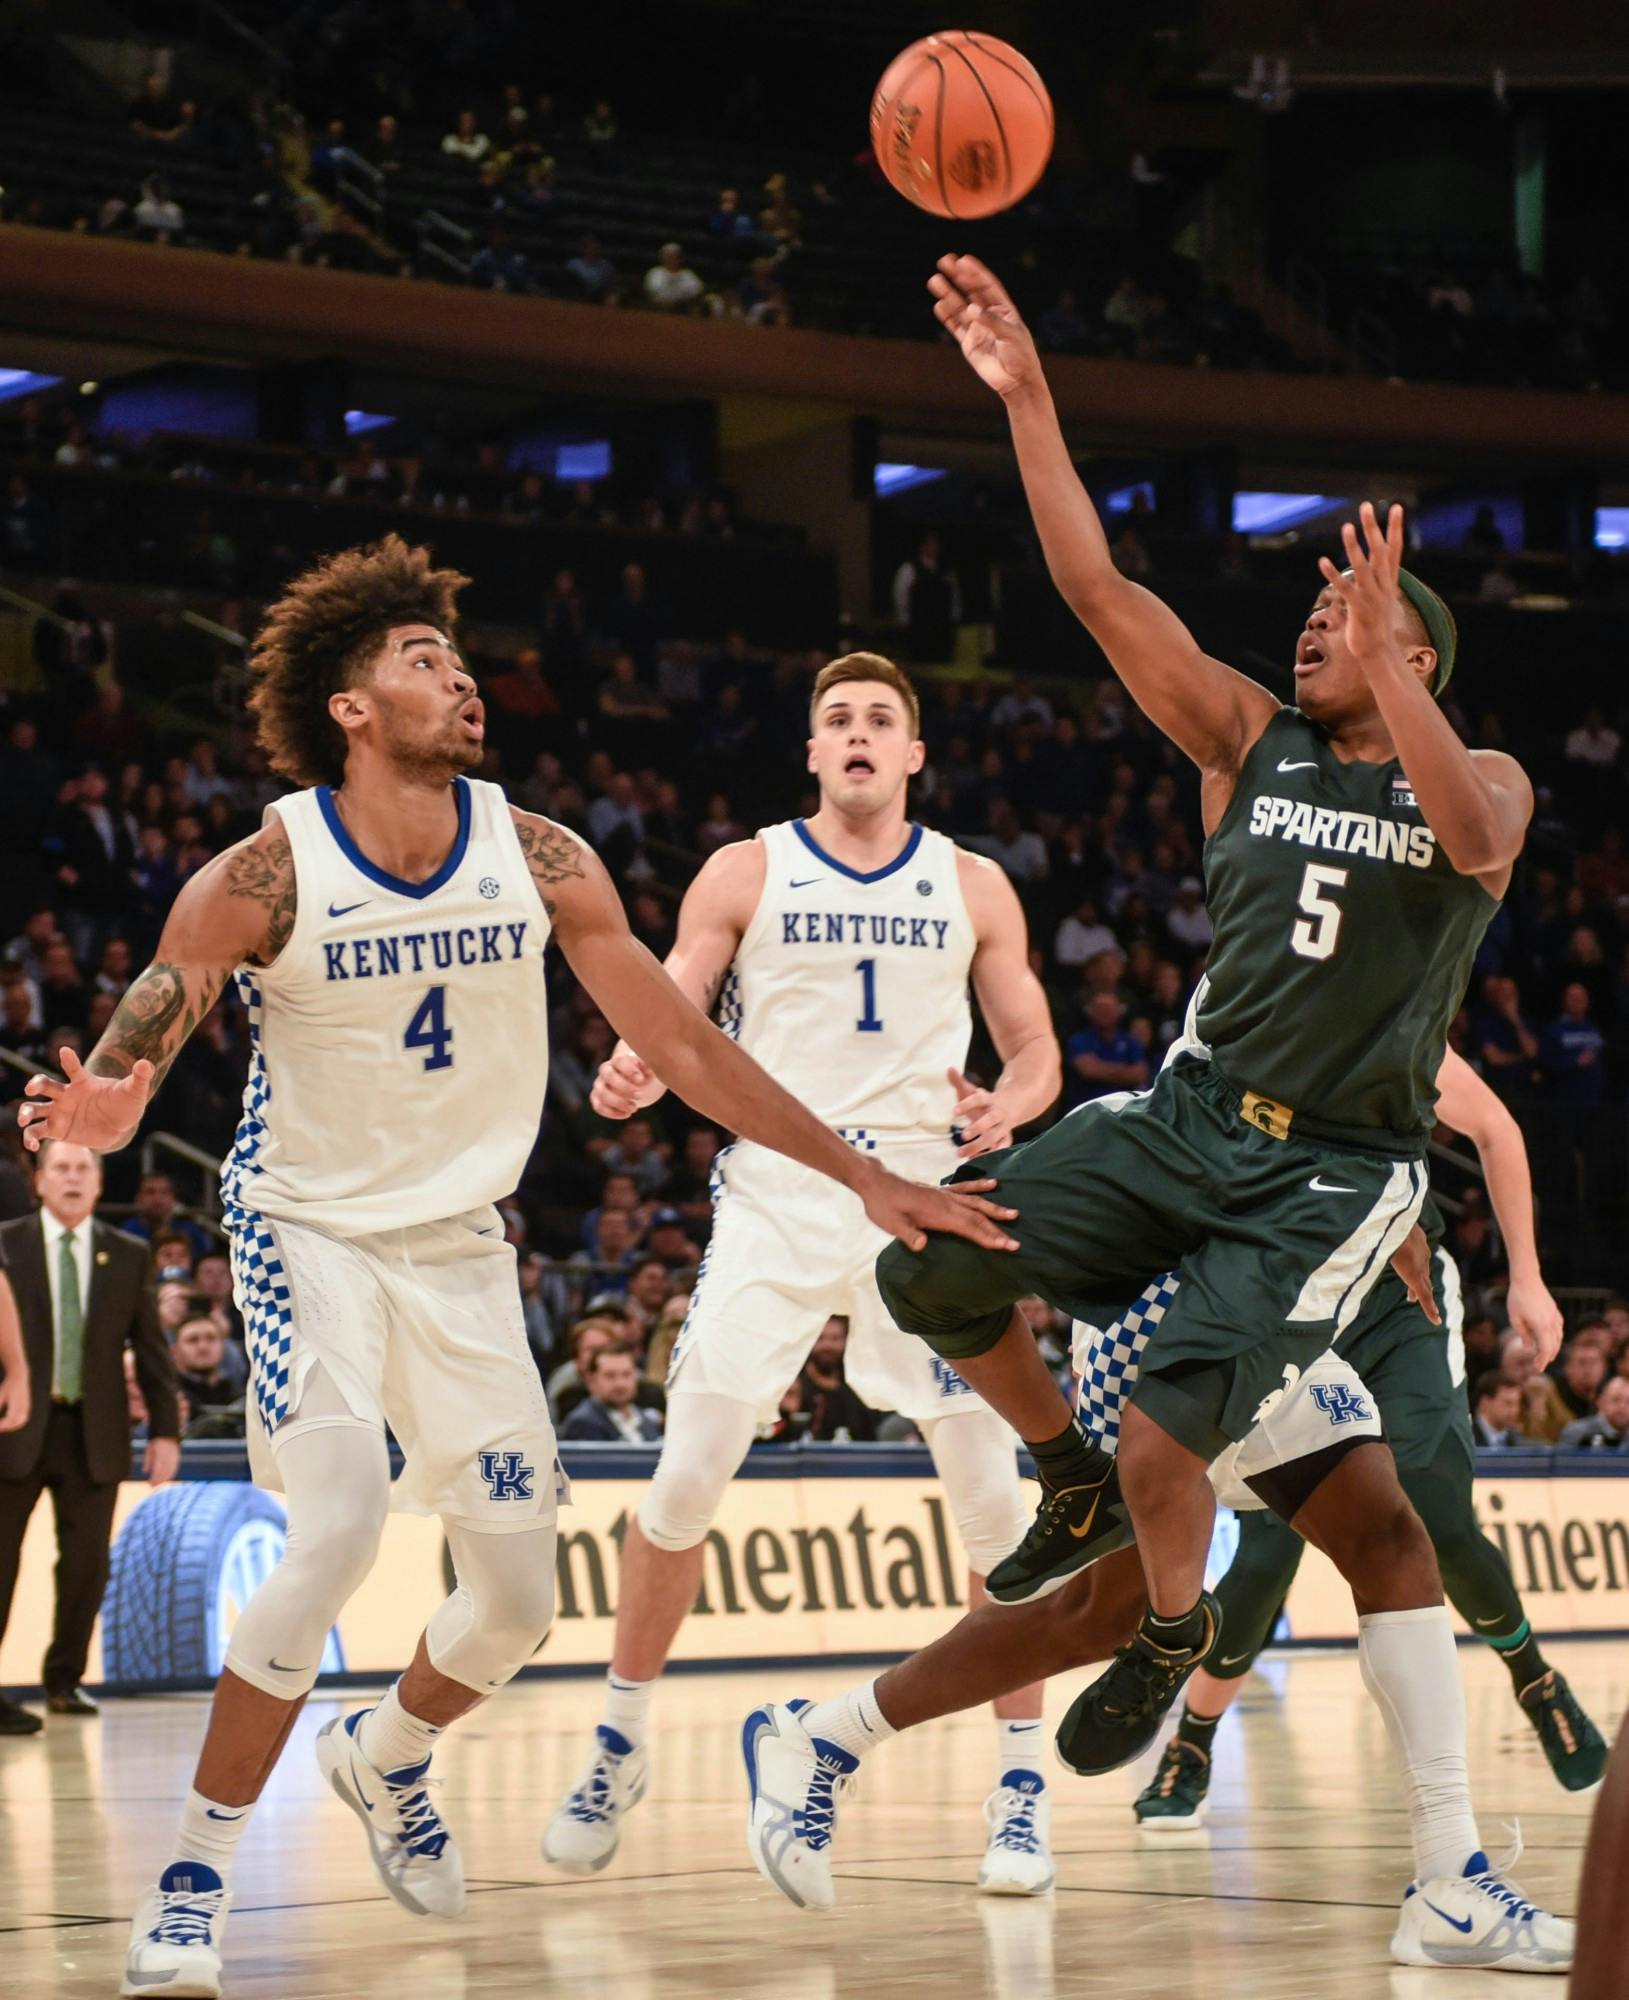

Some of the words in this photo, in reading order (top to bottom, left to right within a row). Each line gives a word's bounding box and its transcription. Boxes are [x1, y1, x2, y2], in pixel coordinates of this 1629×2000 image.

[1250, 795, 1436, 869] SPARTANS
[782, 912, 949, 949] KENTUCKY
[1291, 861, 1349, 961] 5
[323, 922, 527, 981] KENTUCKY
[402, 983, 453, 1072] 4
[855, 958, 883, 1032] 1
[1310, 1384, 1373, 1425] UK
[478, 1451, 534, 1500] UK
